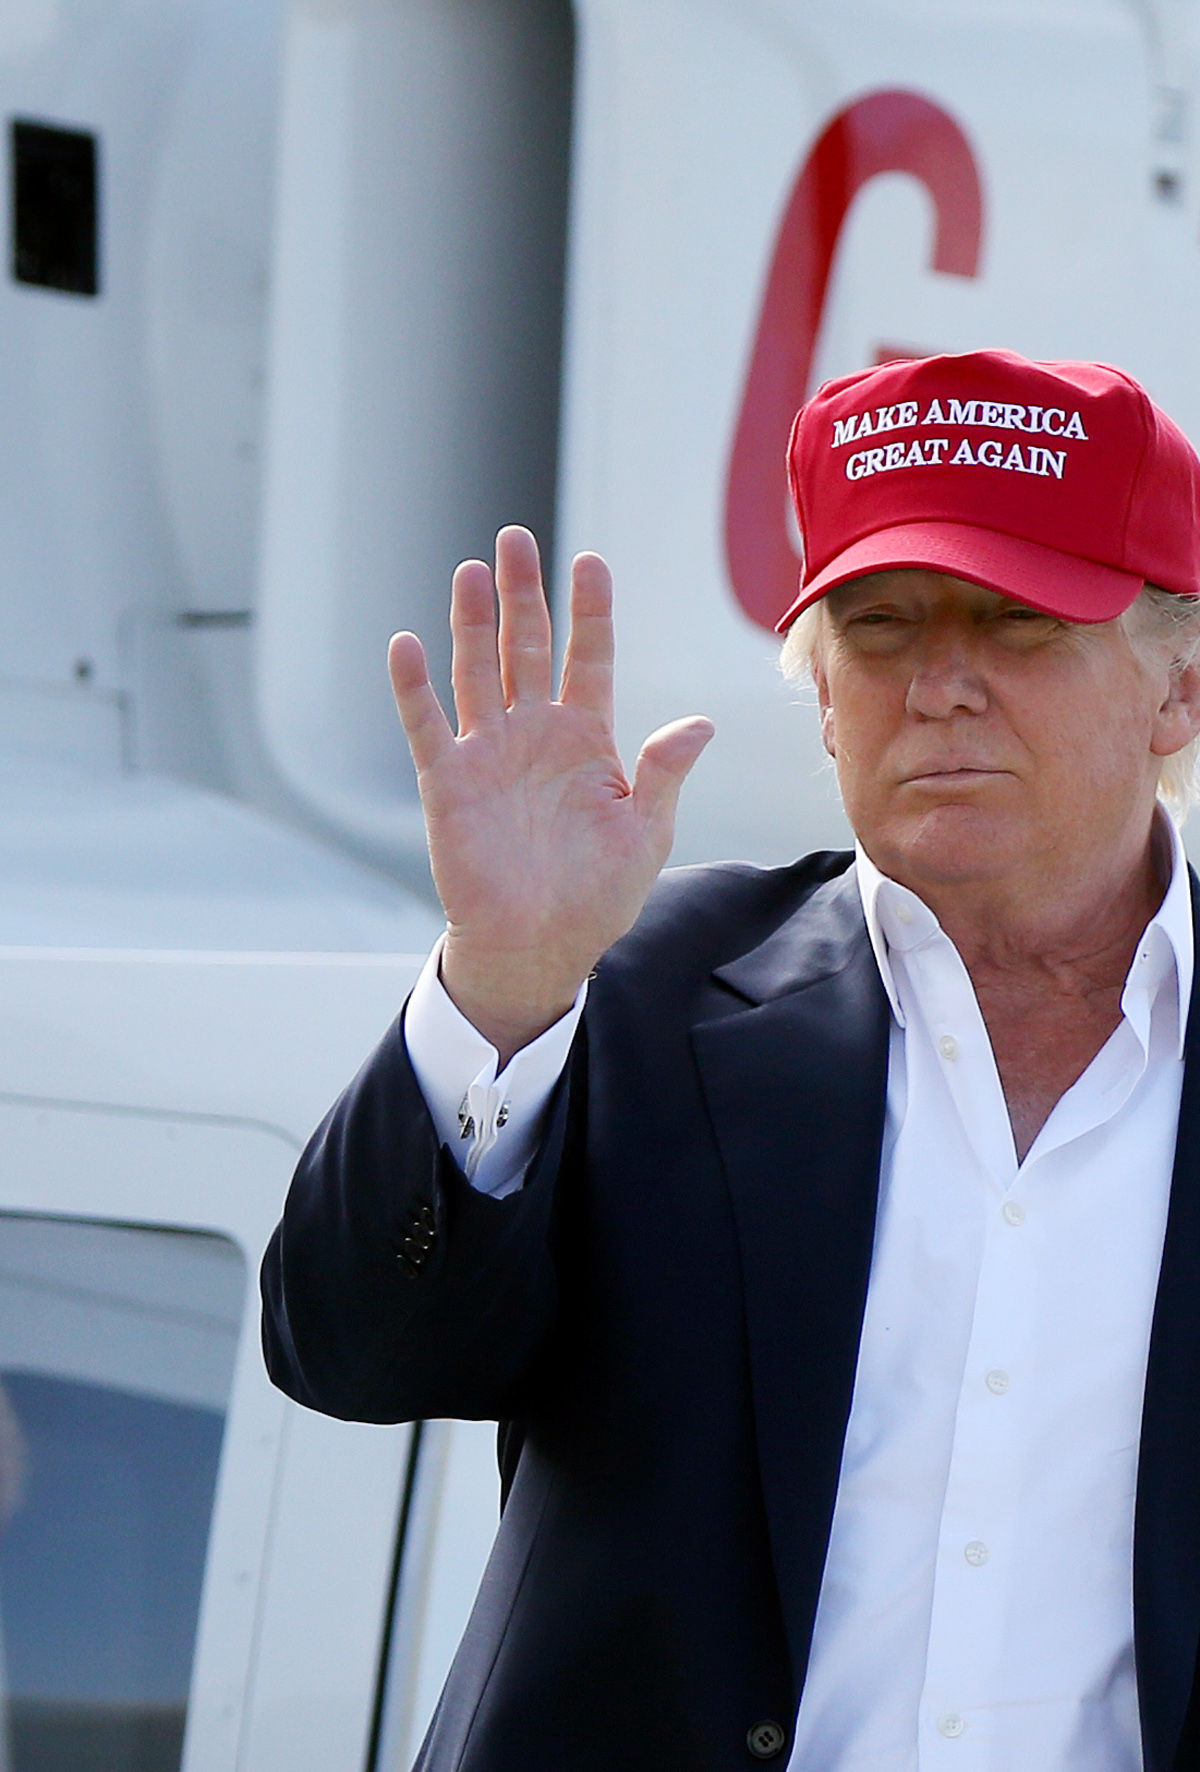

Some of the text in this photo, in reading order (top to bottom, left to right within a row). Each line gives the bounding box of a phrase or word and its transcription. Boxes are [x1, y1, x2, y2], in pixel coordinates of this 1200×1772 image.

[831, 399, 1089, 448] MAKE AMERICA
[845, 439, 1067, 480] GREAT AGAIN
